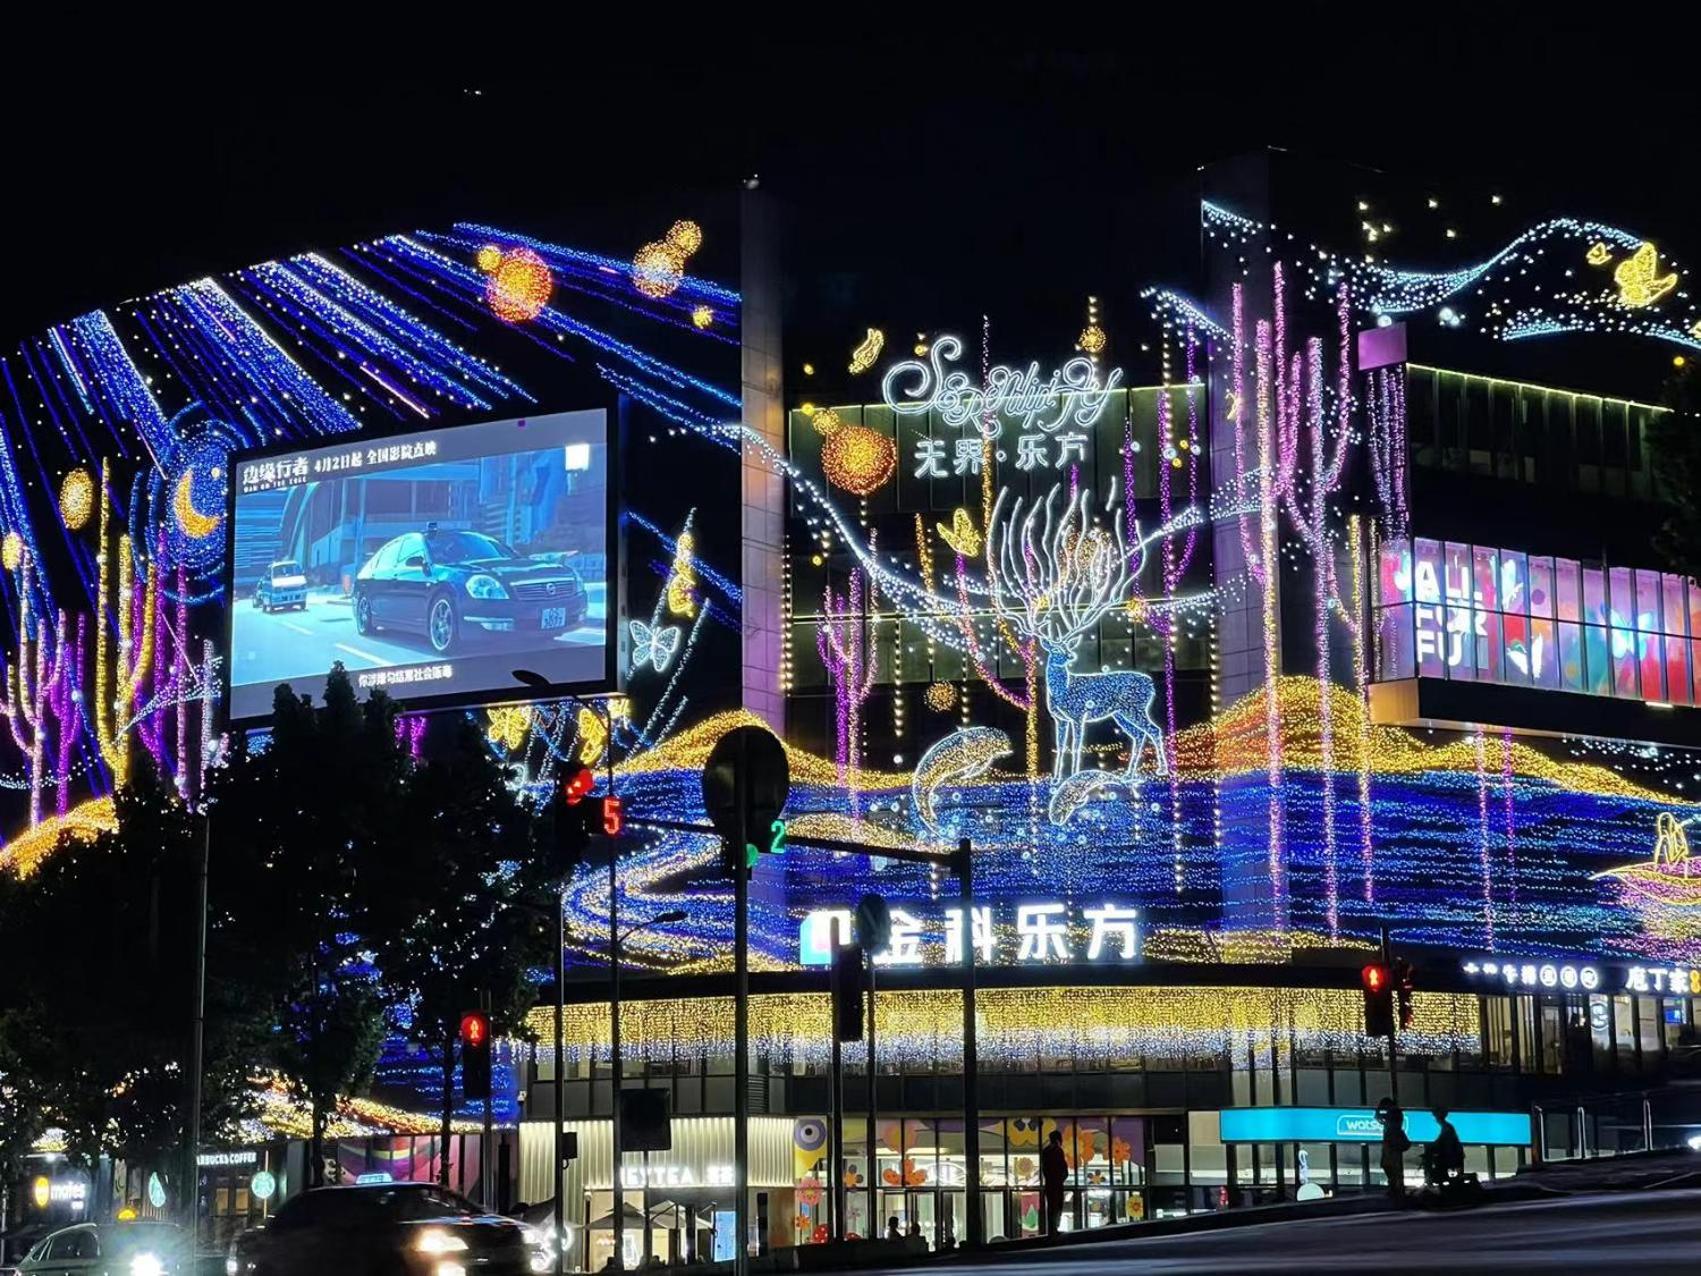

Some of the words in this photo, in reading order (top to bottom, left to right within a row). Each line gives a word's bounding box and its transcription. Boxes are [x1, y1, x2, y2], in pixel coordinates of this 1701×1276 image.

[242, 457, 309, 485] 边缘行者
[314, 451, 363, 473] 4月2日起
[367, 440, 437, 465] 全国影院点映
[602, 796, 622, 836] 5
[770, 819, 788, 855] 2
[872, 904, 1140, 966] 金科乐方
[229, 1151, 257, 1164] COFFEE
